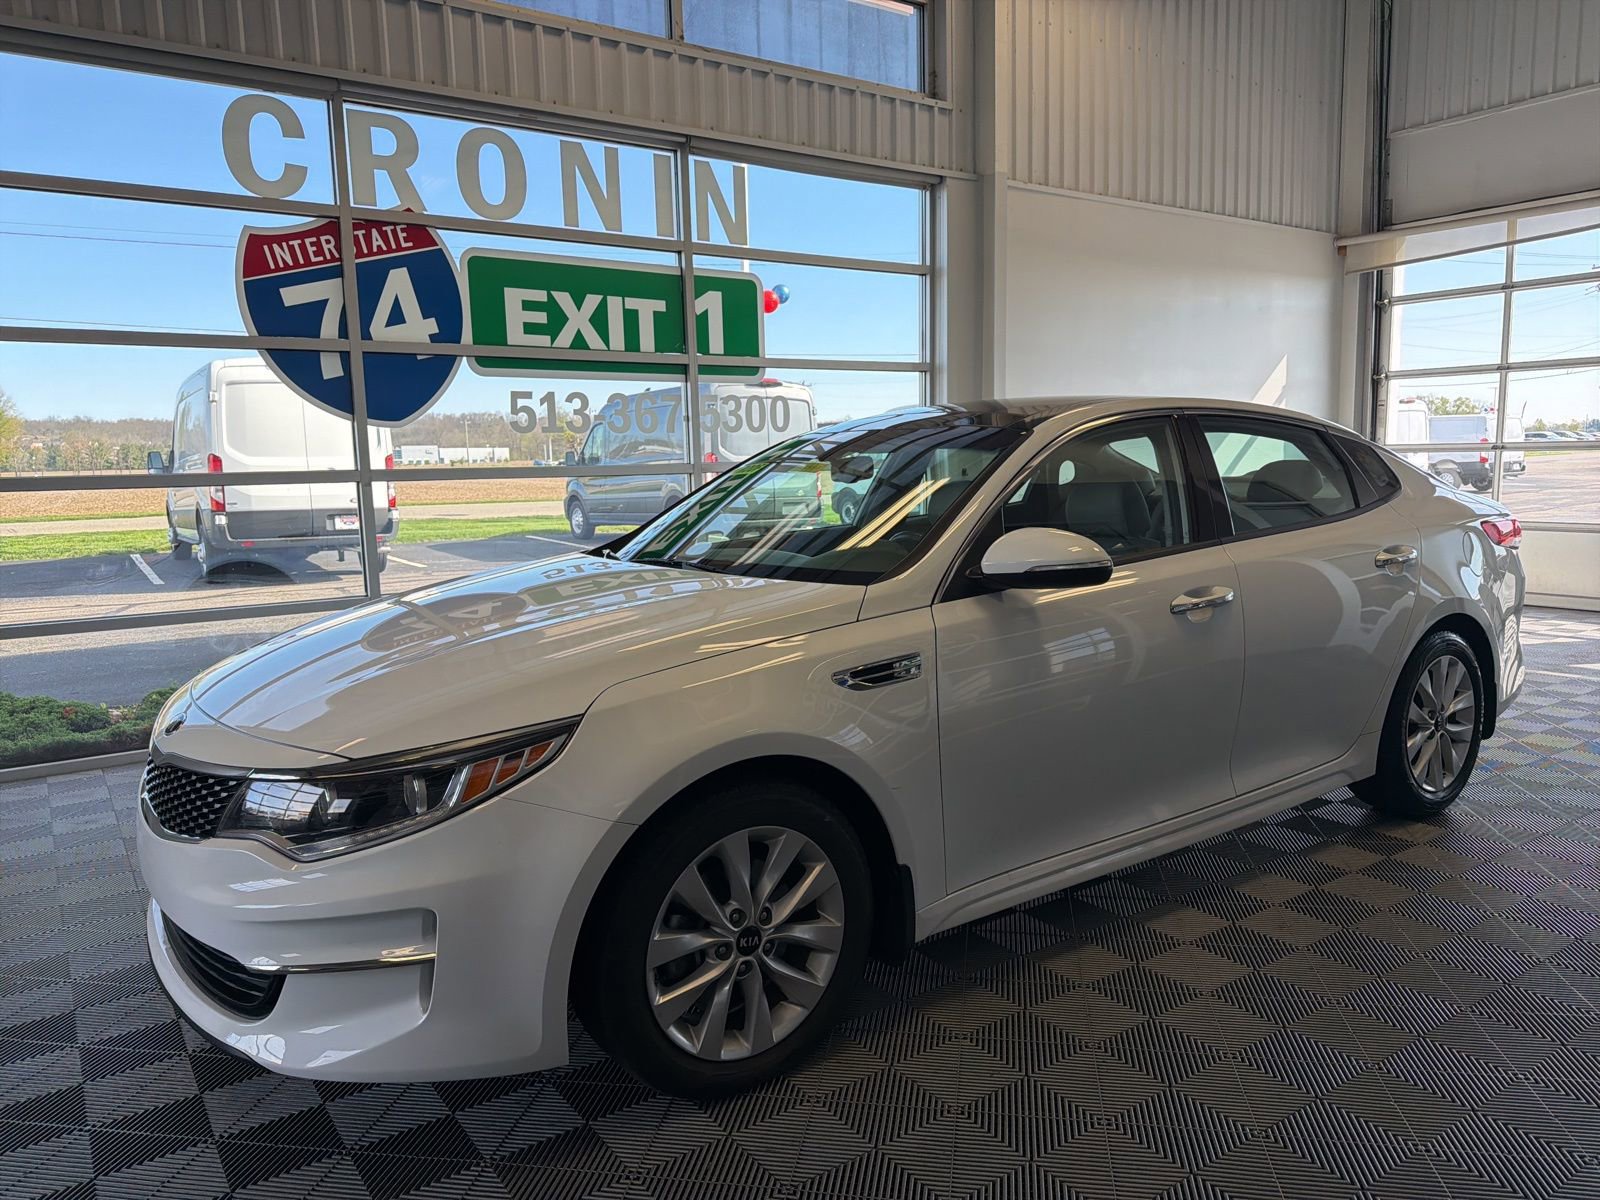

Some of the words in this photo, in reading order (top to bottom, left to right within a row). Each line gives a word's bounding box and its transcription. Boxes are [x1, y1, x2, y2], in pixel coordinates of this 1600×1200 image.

[221, 94, 748, 246] CRONIN
[263, 224, 414, 270] INTERTATE
[279, 266, 440, 380] 74
[503, 287, 667, 353] EXIT
[694, 290, 725, 355] 1
[740, 936, 759, 947] KIA
